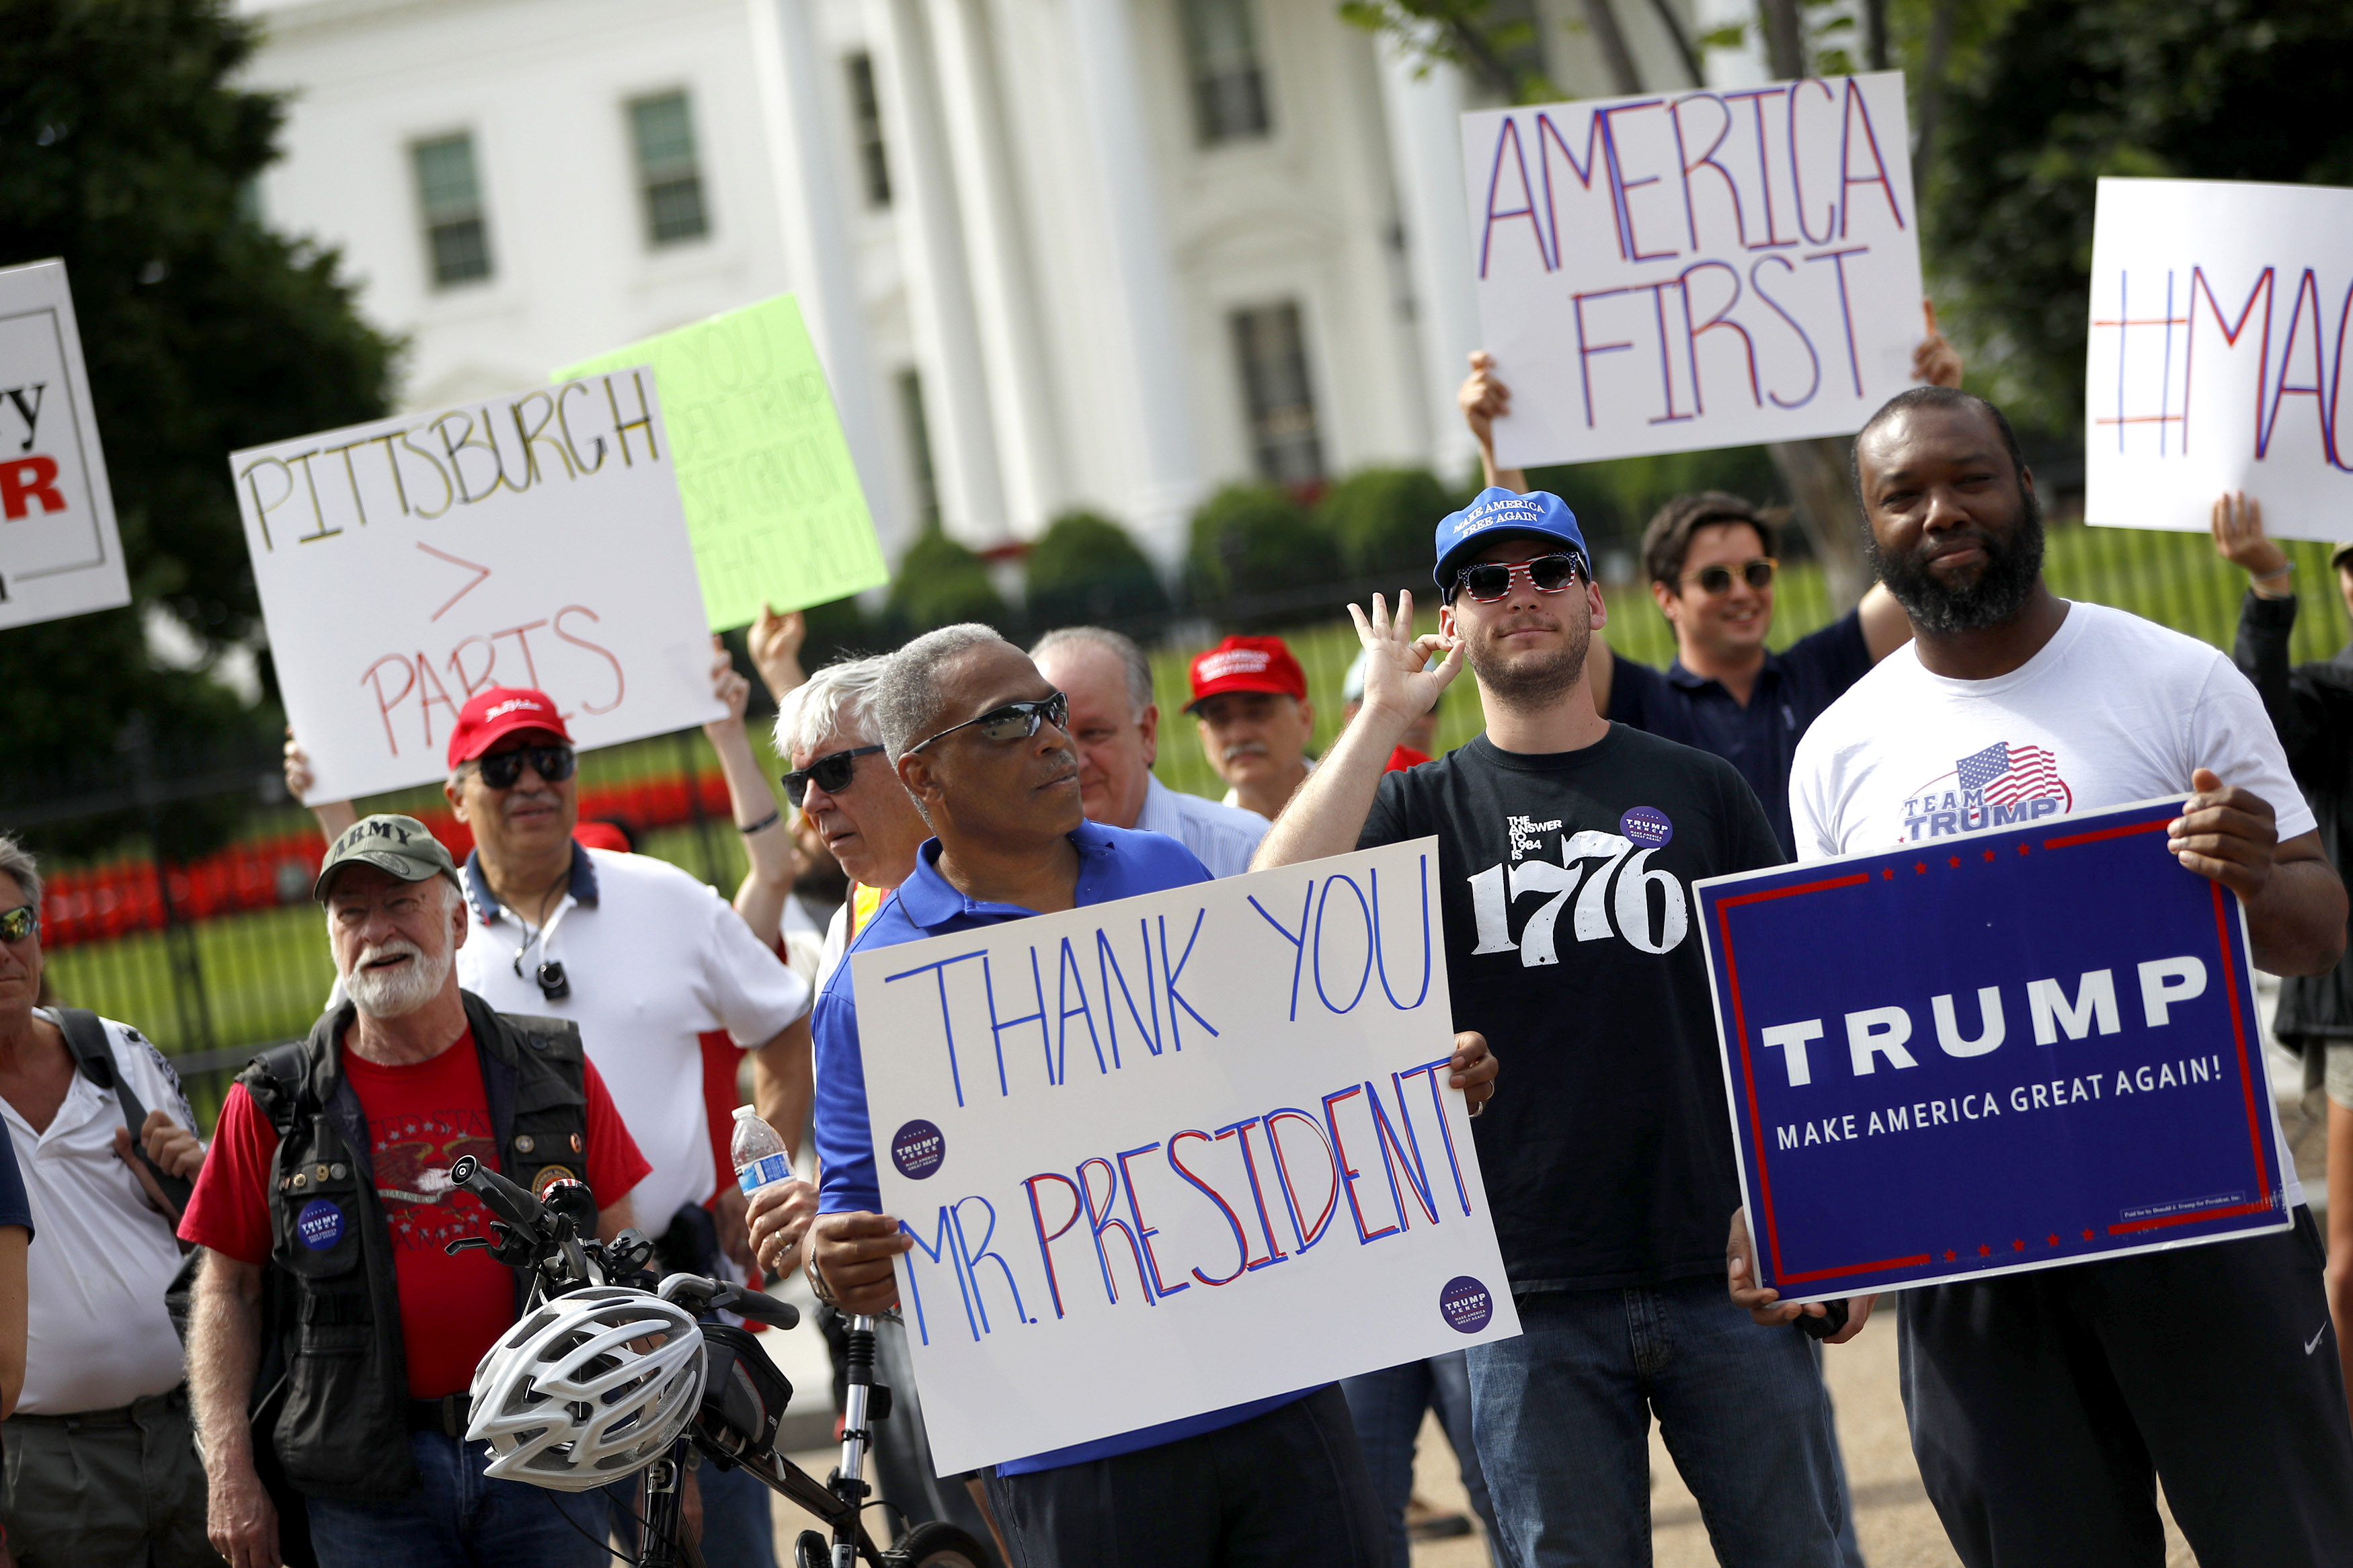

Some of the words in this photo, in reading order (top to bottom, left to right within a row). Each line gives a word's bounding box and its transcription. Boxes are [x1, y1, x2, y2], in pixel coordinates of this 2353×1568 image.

[1479, 75, 1906, 280] AMERICA
[1570, 246, 1870, 429] FIRST
[240, 372, 659, 552] PITTSBURGH
[1453, 506, 1483, 534] MAKE
[1485, 500, 1546, 513] AMERICA
[1462, 516, 1493, 538] FREE
[1496, 511, 1538, 524] AGAIN
[1904, 788, 1985, 818] TEAM
[1507, 815, 1530, 825] THE
[1509, 820, 1562, 835] ANSWER
[1626, 819, 1669, 831] TRUMP
[1629, 825, 1664, 835] PENCE
[1904, 797, 2059, 841] TRUMP
[335, 821, 411, 857] ARMY
[1511, 832, 1527, 842] TO
[1511, 839, 1542, 850] 1984
[1511, 850, 1523, 860] IS
[1467, 830, 1688, 967] 1776
[884, 907, 1220, 1108] THANK
[1246, 854, 1431, 1022] YOU
[1761, 955, 2208, 1087] TRUMP
[1776, 1115, 1858, 1150] MAKE
[1867, 1091, 2001, 1136] AMERICA
[2010, 1074, 2104, 1112] GREAT
[2114, 1055, 2222, 1096] AGAIN!
[896, 1137, 939, 1156] TRUMP
[902, 1145, 937, 1161] PENCE
[898, 1195, 1038, 1346] MR.
[1020, 1057, 1472, 1321] PRESIDENT
[301, 1214, 339, 1231] TRUMP
[1445, 1293, 1486, 1311] TRUMP
[1451, 1301, 1484, 1315] PENCE
